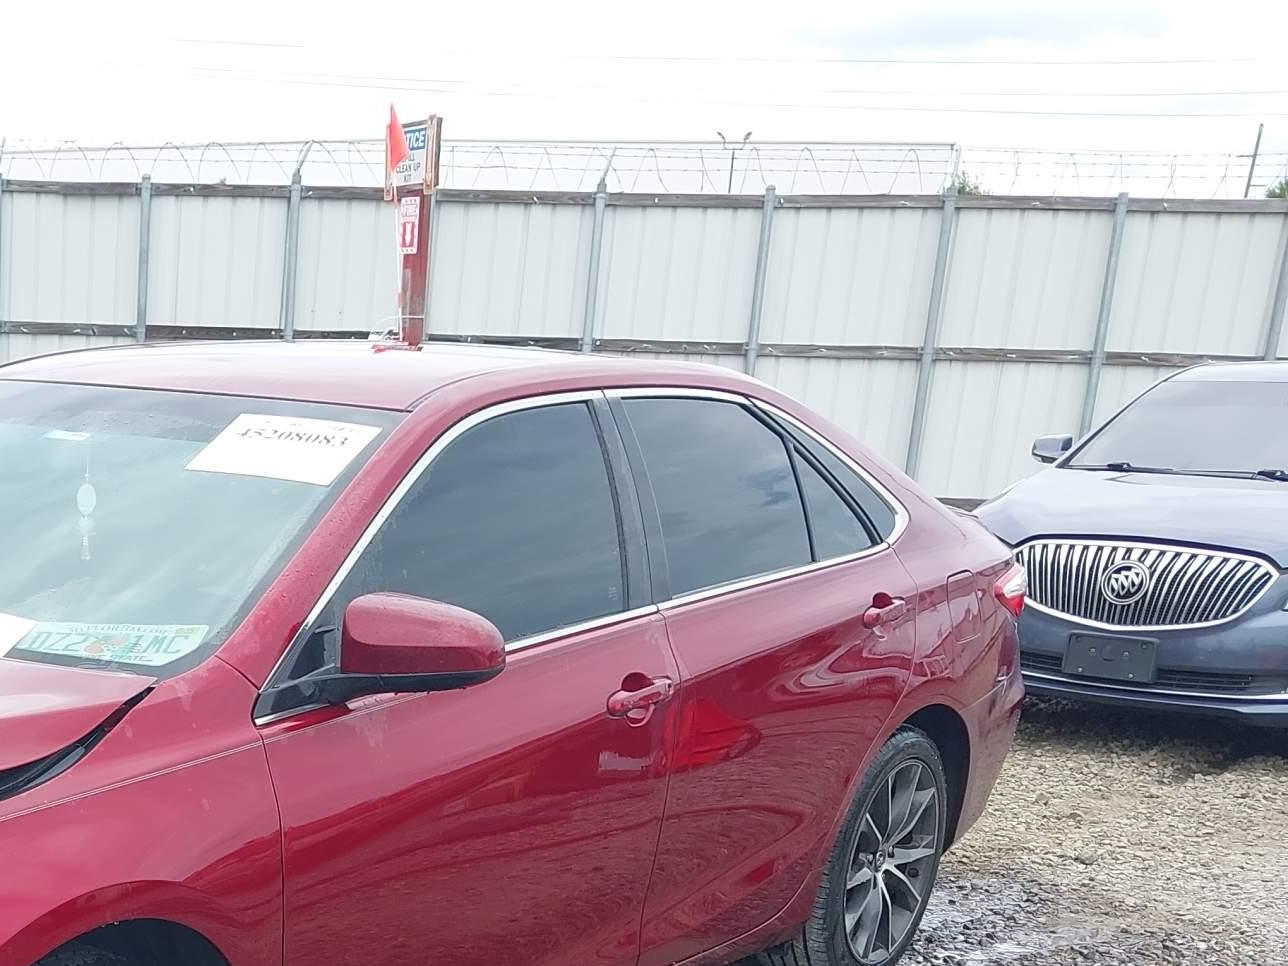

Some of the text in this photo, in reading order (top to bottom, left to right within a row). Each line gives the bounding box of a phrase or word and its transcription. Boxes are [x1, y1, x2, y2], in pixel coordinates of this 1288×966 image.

[405, 131, 425, 148] TICE
[396, 162, 421, 174] CLEAN UP
[403, 173, 412, 183] KIT
[236, 427, 349, 447] 45208083
